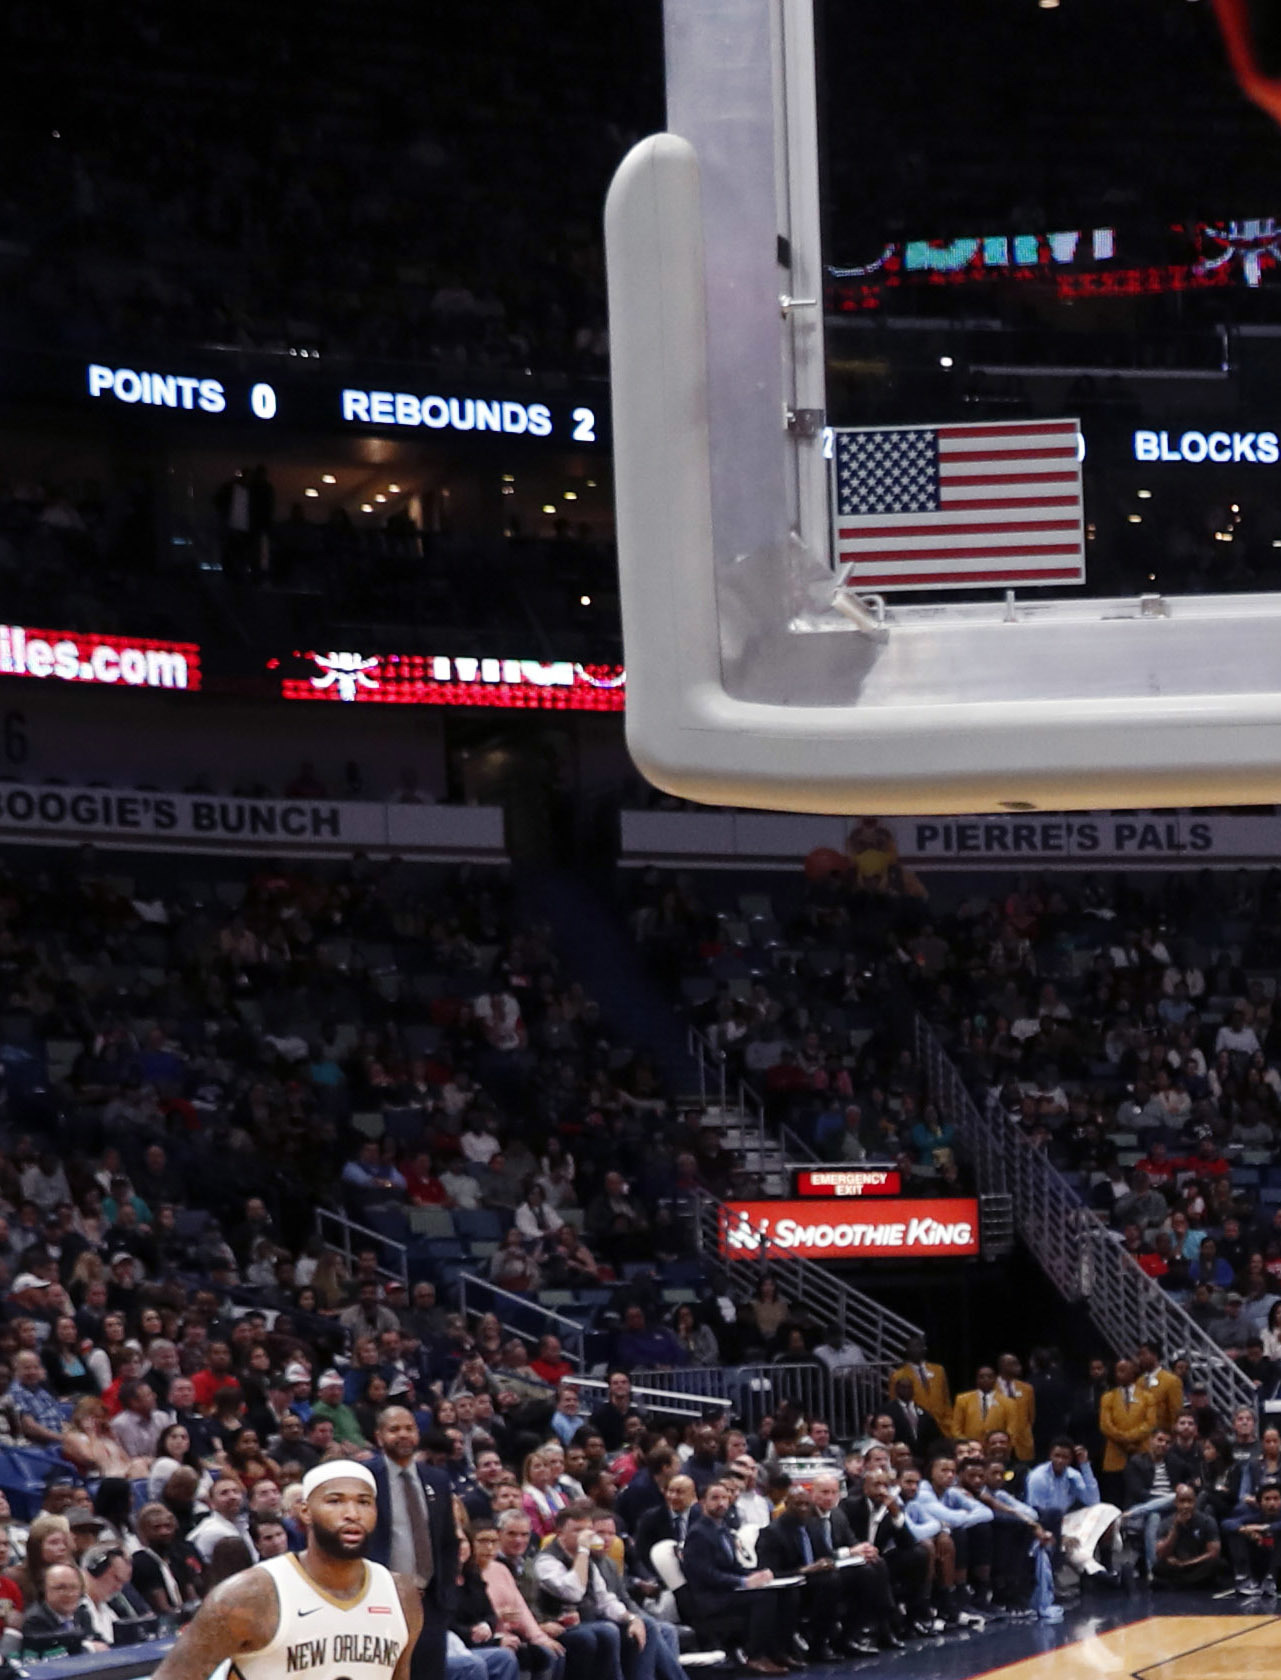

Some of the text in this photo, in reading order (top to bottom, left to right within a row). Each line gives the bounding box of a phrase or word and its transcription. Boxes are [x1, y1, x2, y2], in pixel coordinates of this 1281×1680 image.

[88, 364, 277, 420] POINTS 0
[342, 389, 596, 442] REBOUNDS 2
[1134, 429, 1281, 463] BLOCKS
[192, 801, 341, 837] BUNCH
[915, 822, 1214, 855] PIERRE'S PALS
[810, 1172, 888, 1186] EMERGENCY
[834, 1184, 864, 1196] EXIT
[774, 1218, 906, 1248] SMOOTHIE
[287, 1634, 400, 1673] NEW ORLEANS
